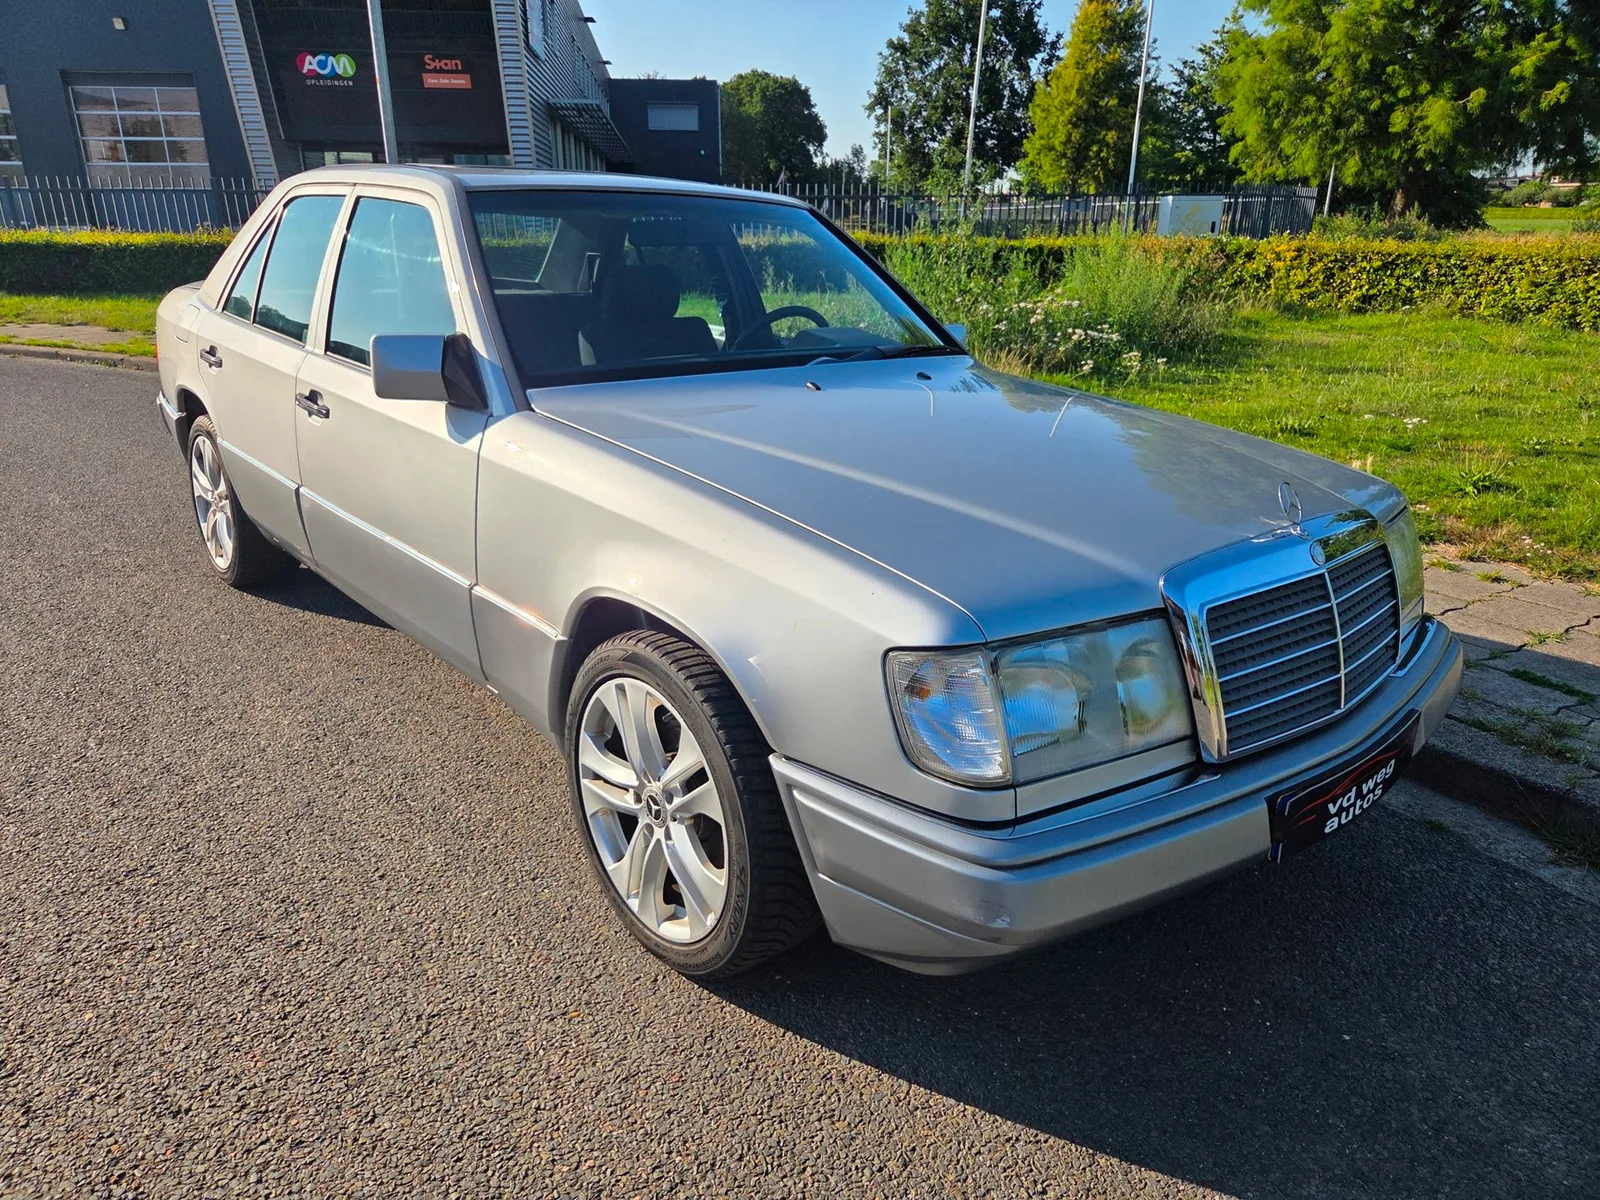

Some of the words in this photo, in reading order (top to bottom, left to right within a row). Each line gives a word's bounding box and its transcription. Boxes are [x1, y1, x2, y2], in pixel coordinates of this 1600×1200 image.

[302, 54, 354, 75] ACM
[305, 79, 354, 87] OPLEIDINGEN
[1327, 786, 1357, 815] vd
[1361, 758, 1396, 796] weg
[1324, 784, 1383, 834] autos
